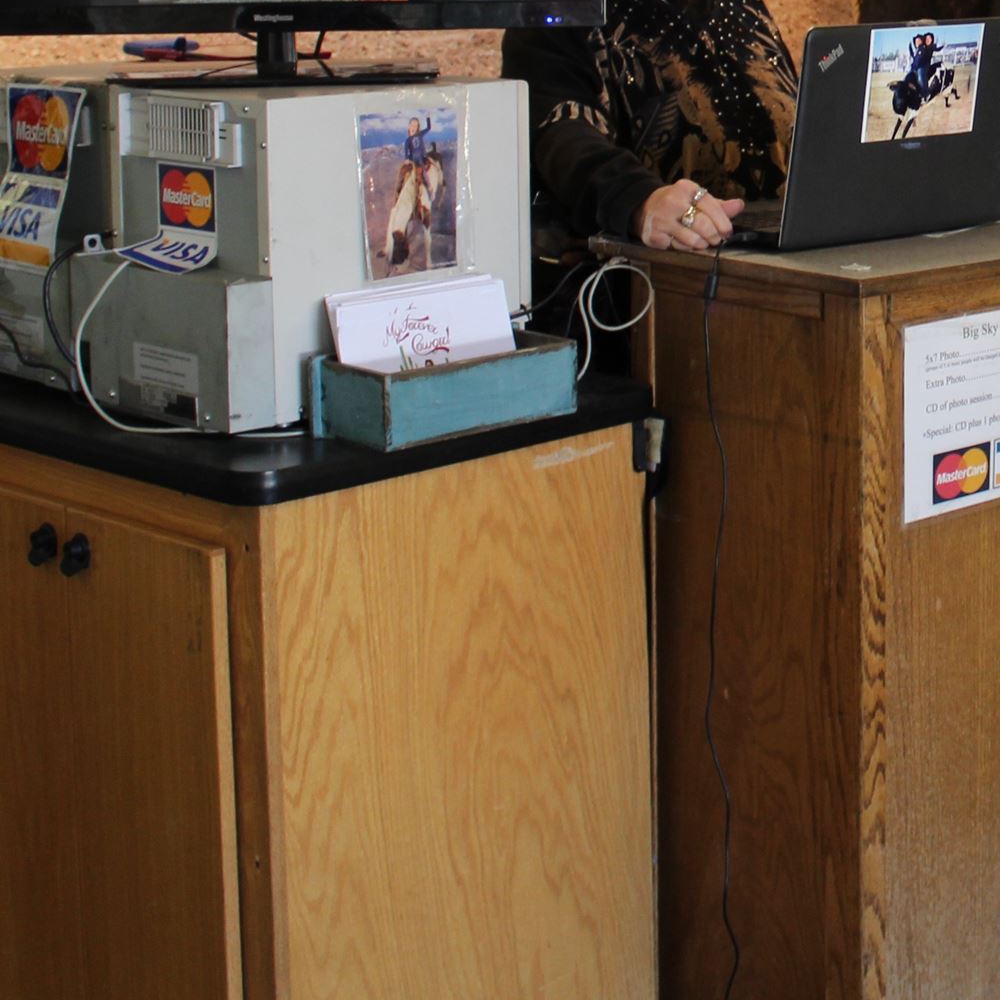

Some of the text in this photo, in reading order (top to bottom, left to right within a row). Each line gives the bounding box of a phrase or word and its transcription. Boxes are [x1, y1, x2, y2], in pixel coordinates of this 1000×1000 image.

[16, 121, 70, 147] MasterCard
[163, 188, 212, 209] MasterCard
[0, 204, 42, 240] VISA
[153, 239, 209, 265] VISA
[962, 327, 979, 340] Big
[981, 322, 999, 337] Sky
[939, 351, 960, 361] Photo
[925, 379, 944, 389] Extra
[946, 375, 966, 384] Photo
[925, 403, 938, 414] CD
[940, 401, 948, 411] of
[948, 398, 969, 412] photo
[954, 420, 967, 432] CD
[968, 416, 981, 432] plus
[936, 461, 988, 486] MasterCard
